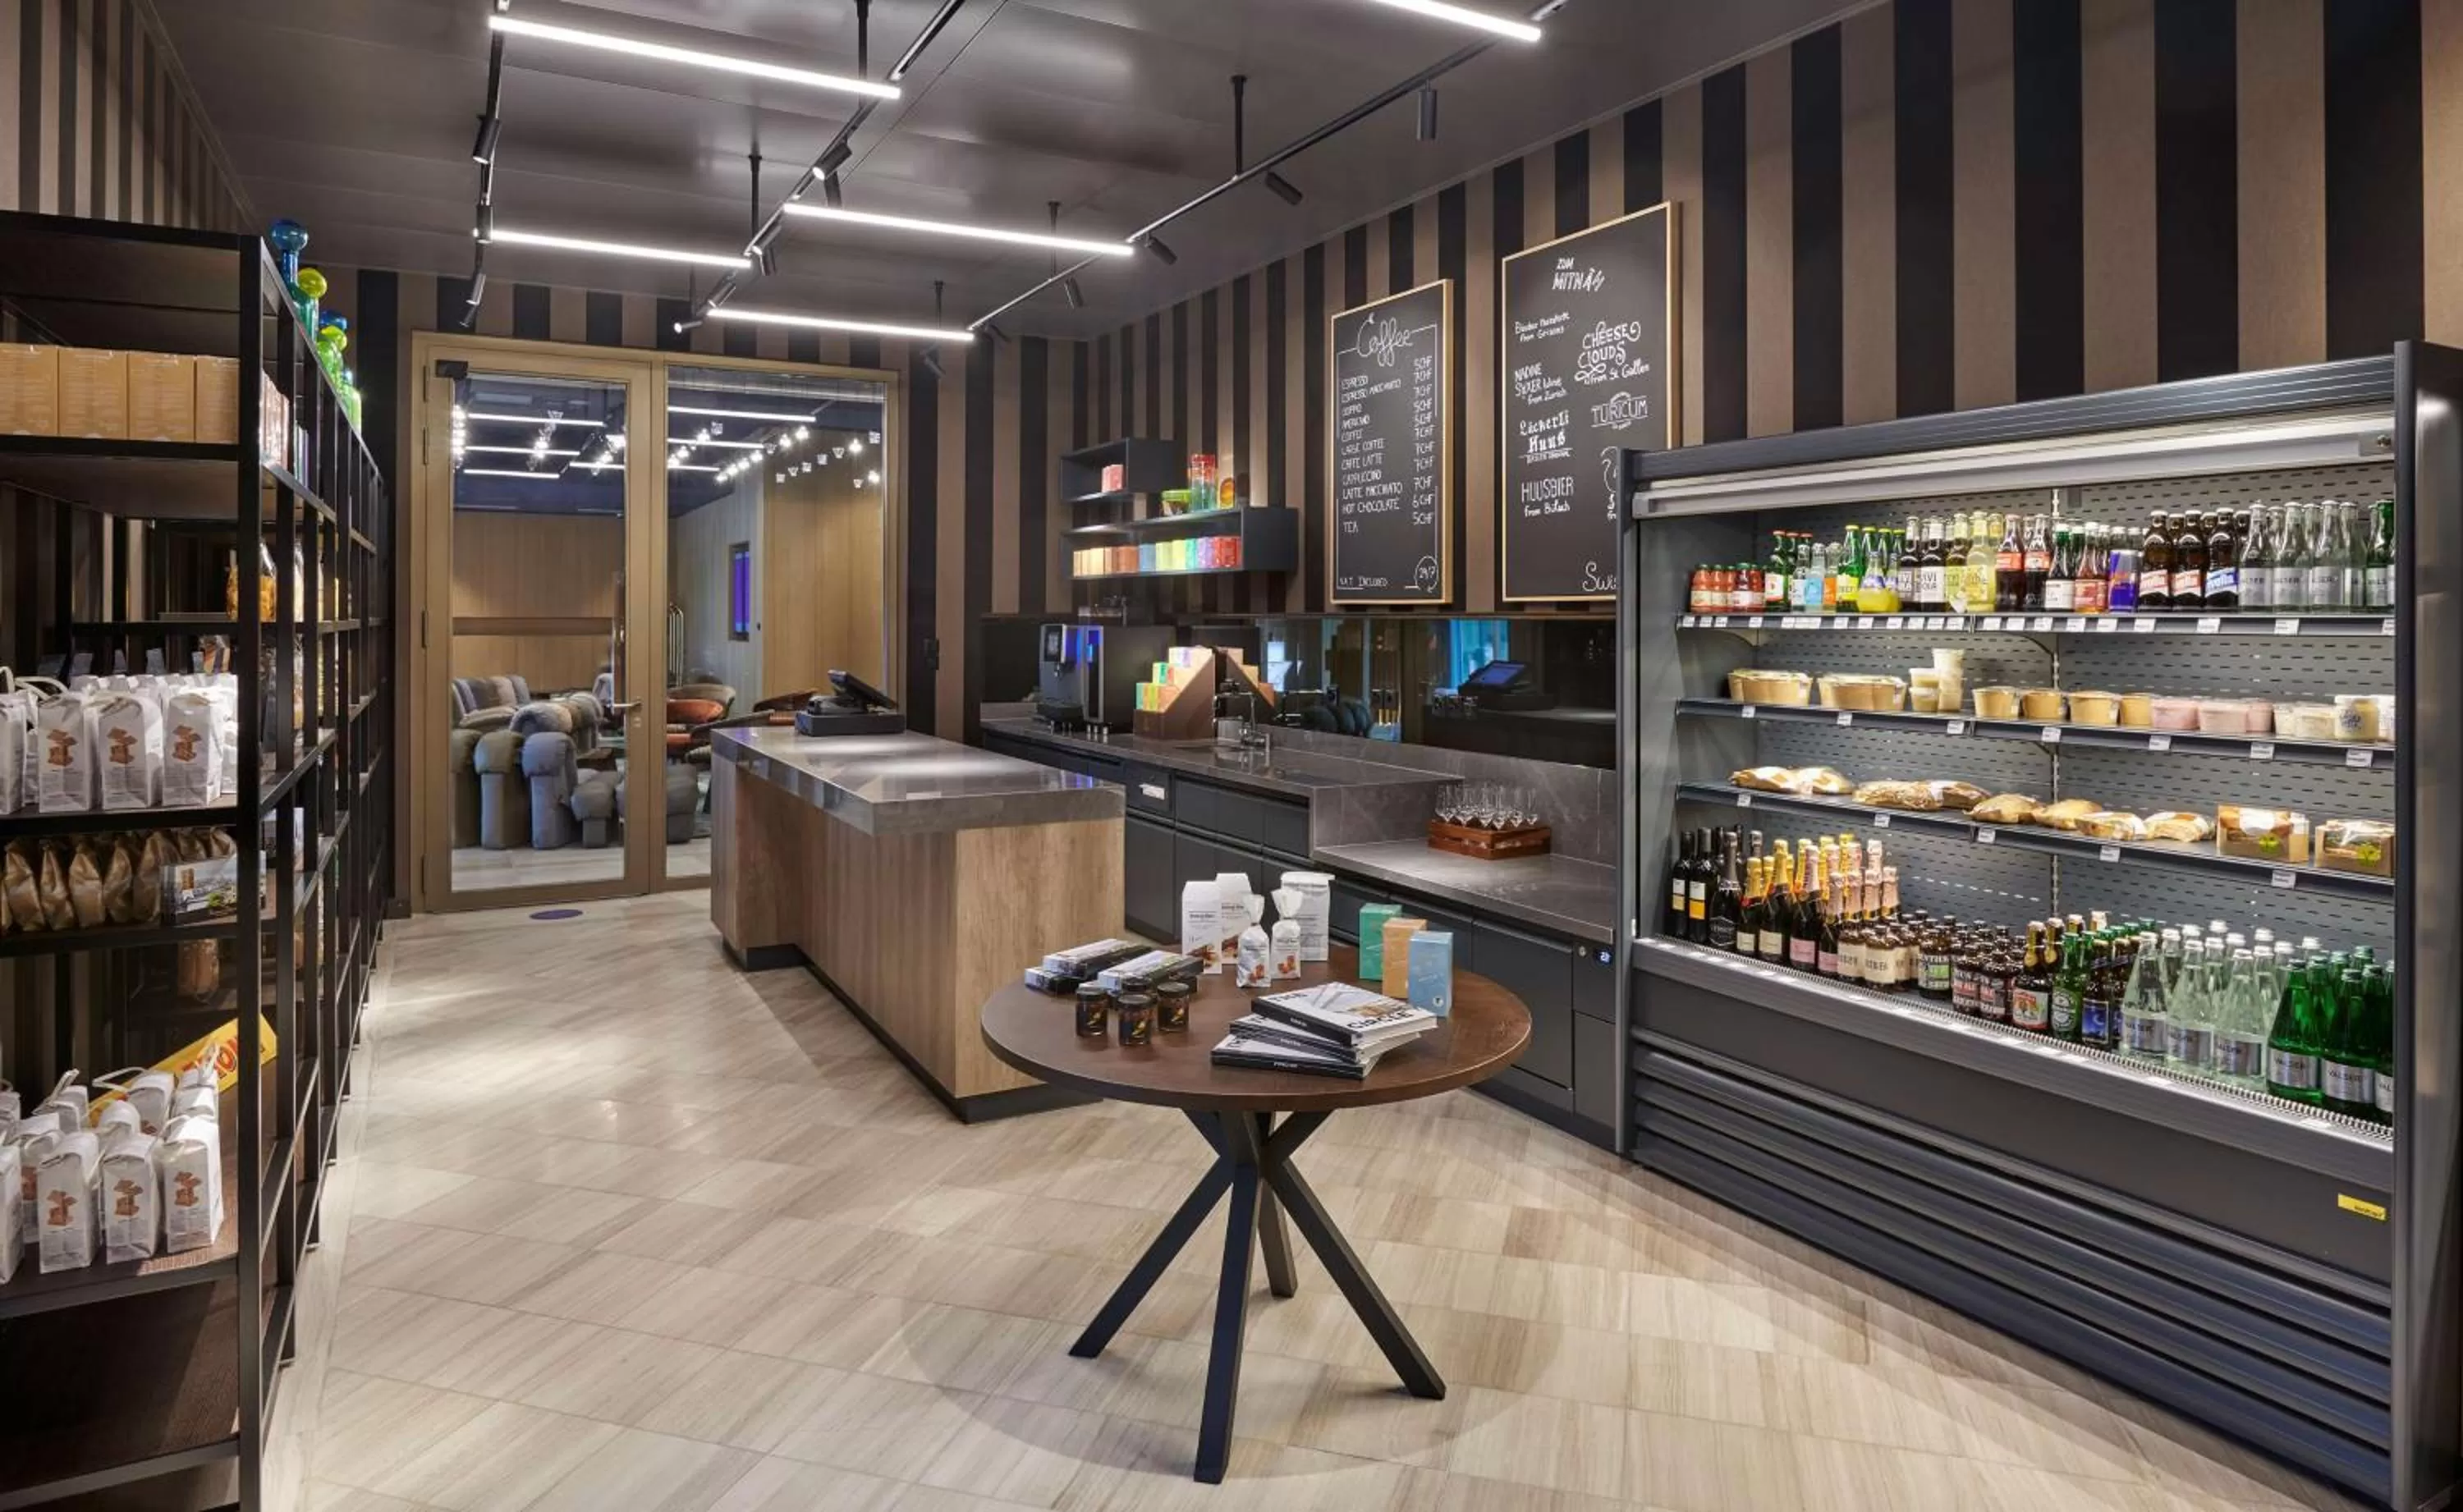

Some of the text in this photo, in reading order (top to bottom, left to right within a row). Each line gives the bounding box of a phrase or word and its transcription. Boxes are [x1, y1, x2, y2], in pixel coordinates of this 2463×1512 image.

[1356, 312, 1413, 367] Coffee
[1582, 321, 1641, 349] CHEESE
[1577, 341, 1626, 369] CLOUDS
[1591, 398, 1649, 424] TURICUM
[1521, 476, 1574, 503] HUUSBIER
[1343, 520, 1359, 533] TEA
